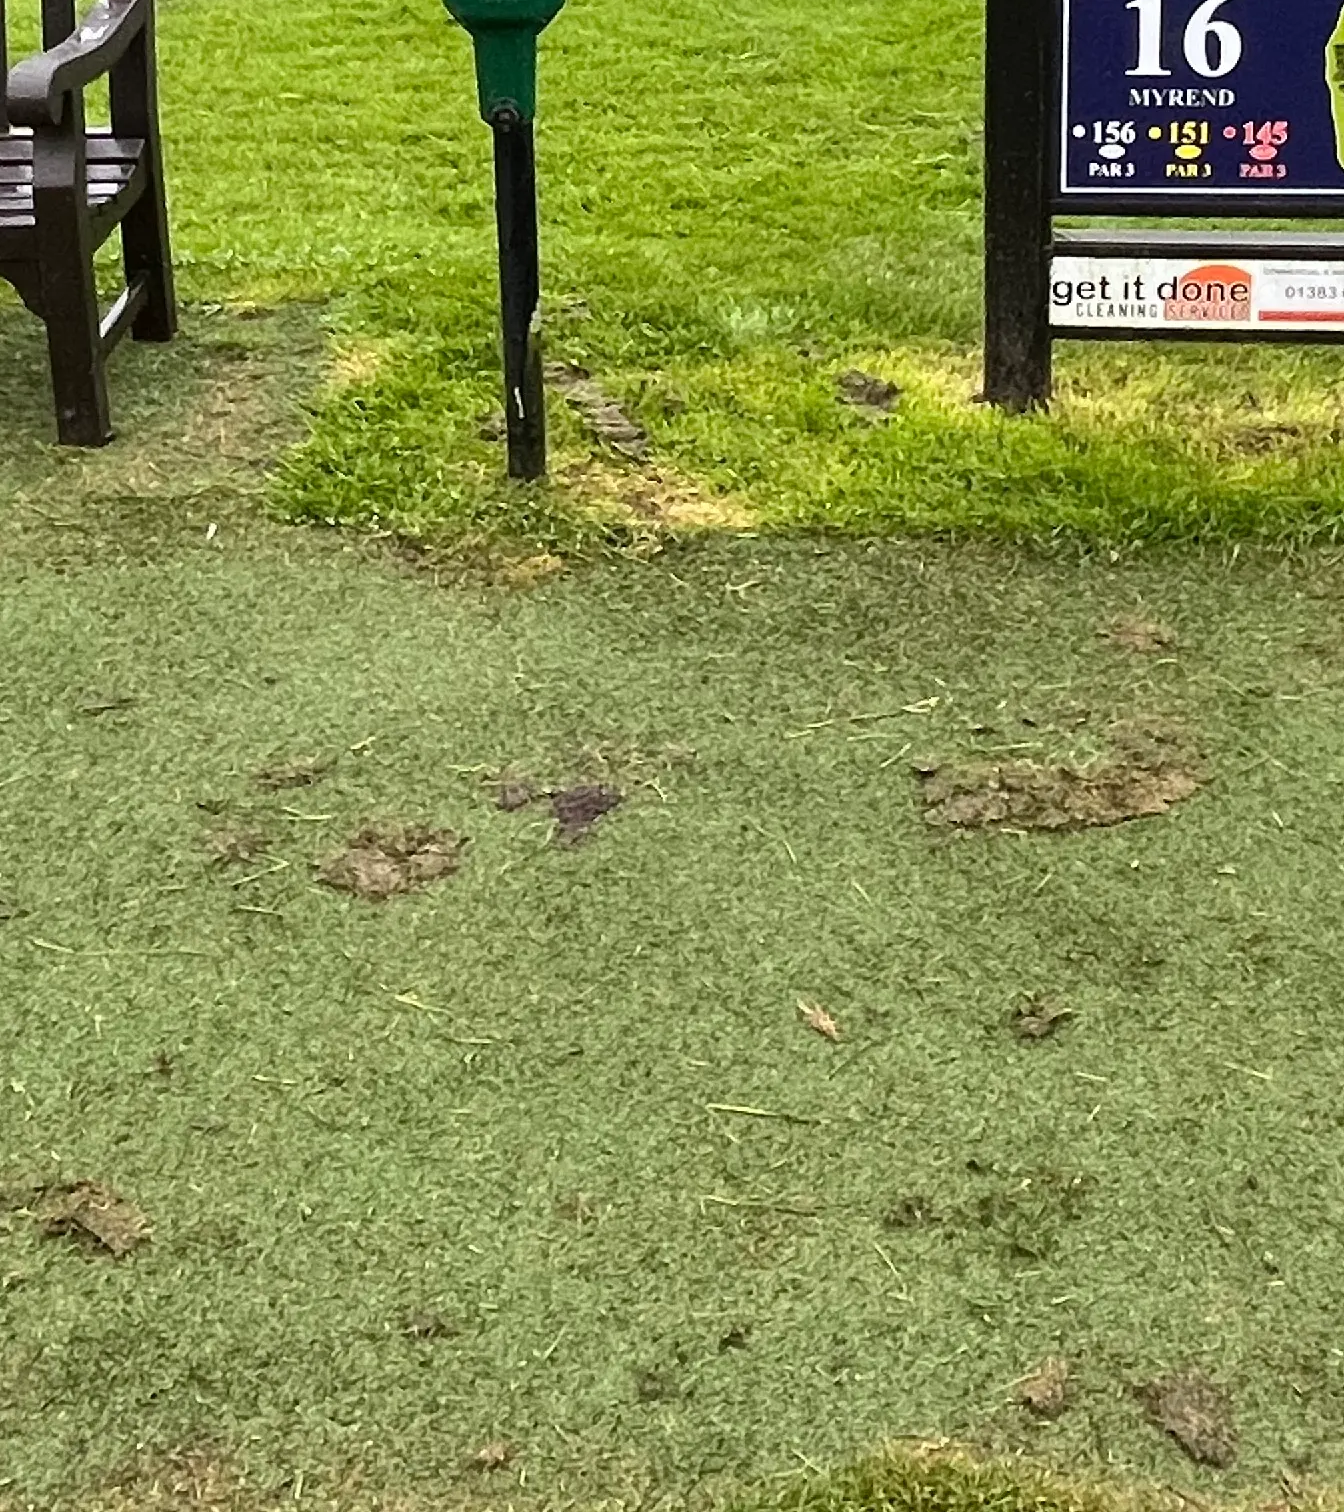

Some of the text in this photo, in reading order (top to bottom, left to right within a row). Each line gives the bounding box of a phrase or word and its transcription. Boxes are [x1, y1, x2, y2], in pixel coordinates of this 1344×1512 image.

[1128, 88, 1235, 107] MYREND
[1092, 120, 1136, 144] 156
[1169, 121, 1209, 144] 151
[1242, 120, 1288, 145] 145
[1088, 162, 1136, 177] PAR 3
[1166, 164, 1212, 178] PAR 3
[1239, 164, 1287, 178] PAR 3
[1052, 274, 1248, 306] get it done
[1284, 286, 1338, 300] 01383
[1076, 302, 1158, 318] CLEANING
